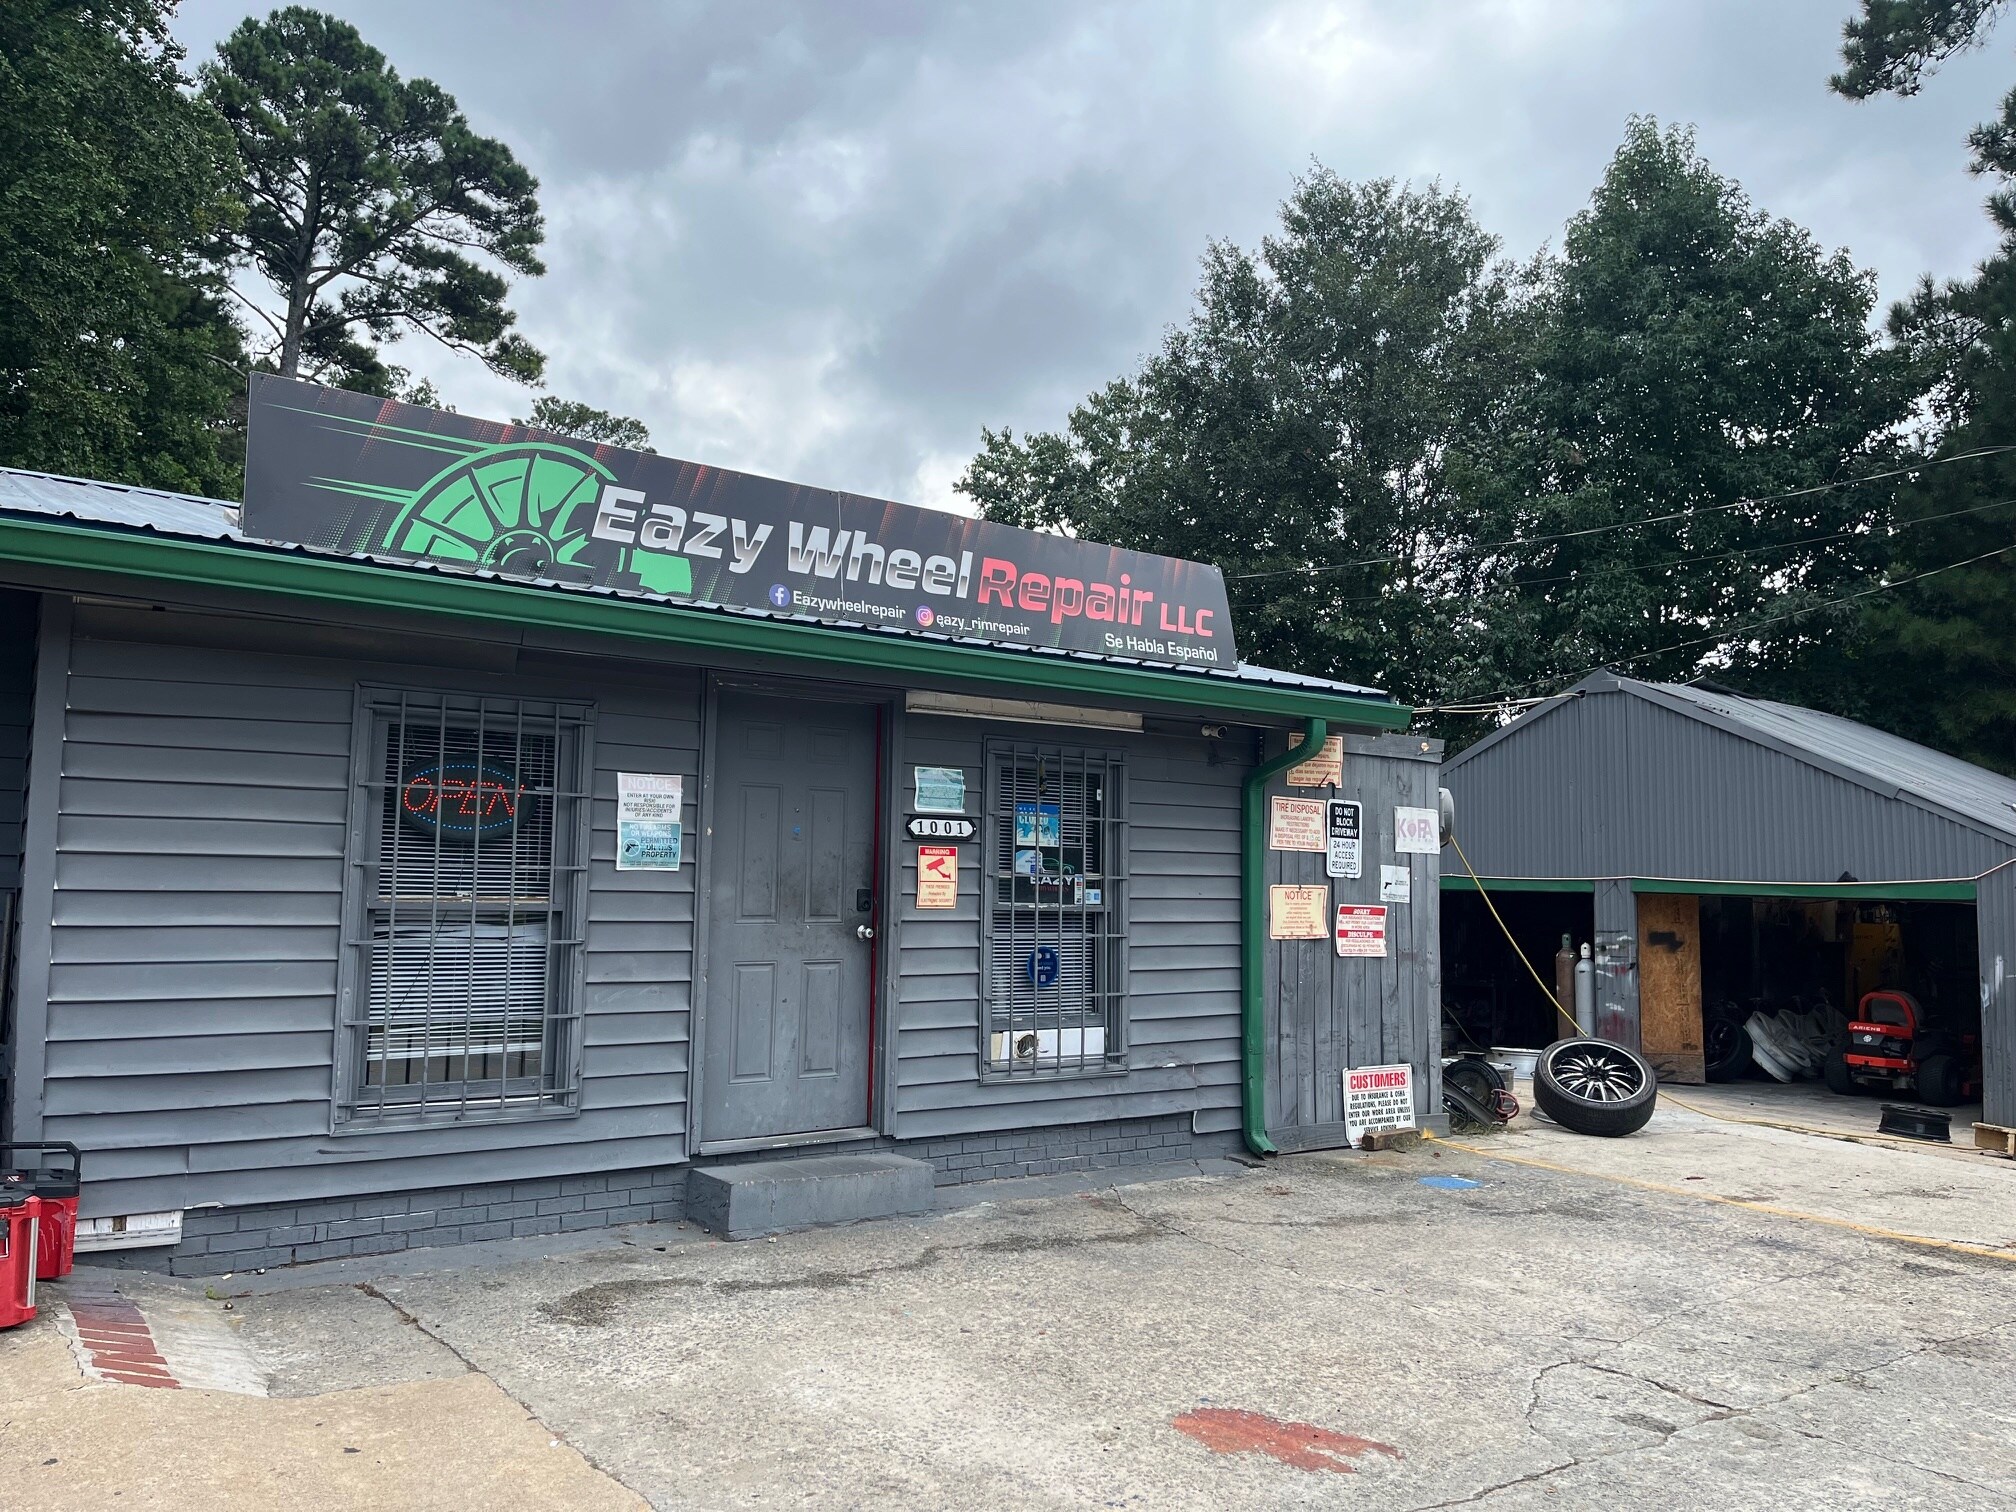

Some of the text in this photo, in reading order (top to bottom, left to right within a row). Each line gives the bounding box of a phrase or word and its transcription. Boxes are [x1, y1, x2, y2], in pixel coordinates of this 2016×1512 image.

[592, 485, 1214, 637] Eazy Wheel Repair LLC
[793, 590, 906, 619] Eazywheelrepair
[936, 613, 1031, 636] eazy_rimrepair
[1105, 632, 1218, 662] Se Habla Español
[628, 777, 672, 790] NOTICE
[404, 777, 526, 816] OPEN
[1276, 802, 1321, 816] TIRE DISPOSAL
[1334, 806, 1354, 816] DO NOT
[1018, 812, 1048, 824] CLOED
[1336, 817, 1354, 826] BLOCK
[917, 820, 964, 835] 1001
[1331, 826, 1358, 837] DRIVEWAY
[1333, 840, 1356, 850] 24 HOUR
[641, 850, 676, 858] PROPERTY
[1334, 851, 1354, 860] ACCESS
[1332, 860, 1356, 870] REQUIRED
[1284, 890, 1312, 900] NOTICE
[1350, 1072, 1406, 1090] CUSTOMERS
[1368, 1092, 1388, 1100] INSURANCE
[1348, 1110, 1360, 1118] ENTER
